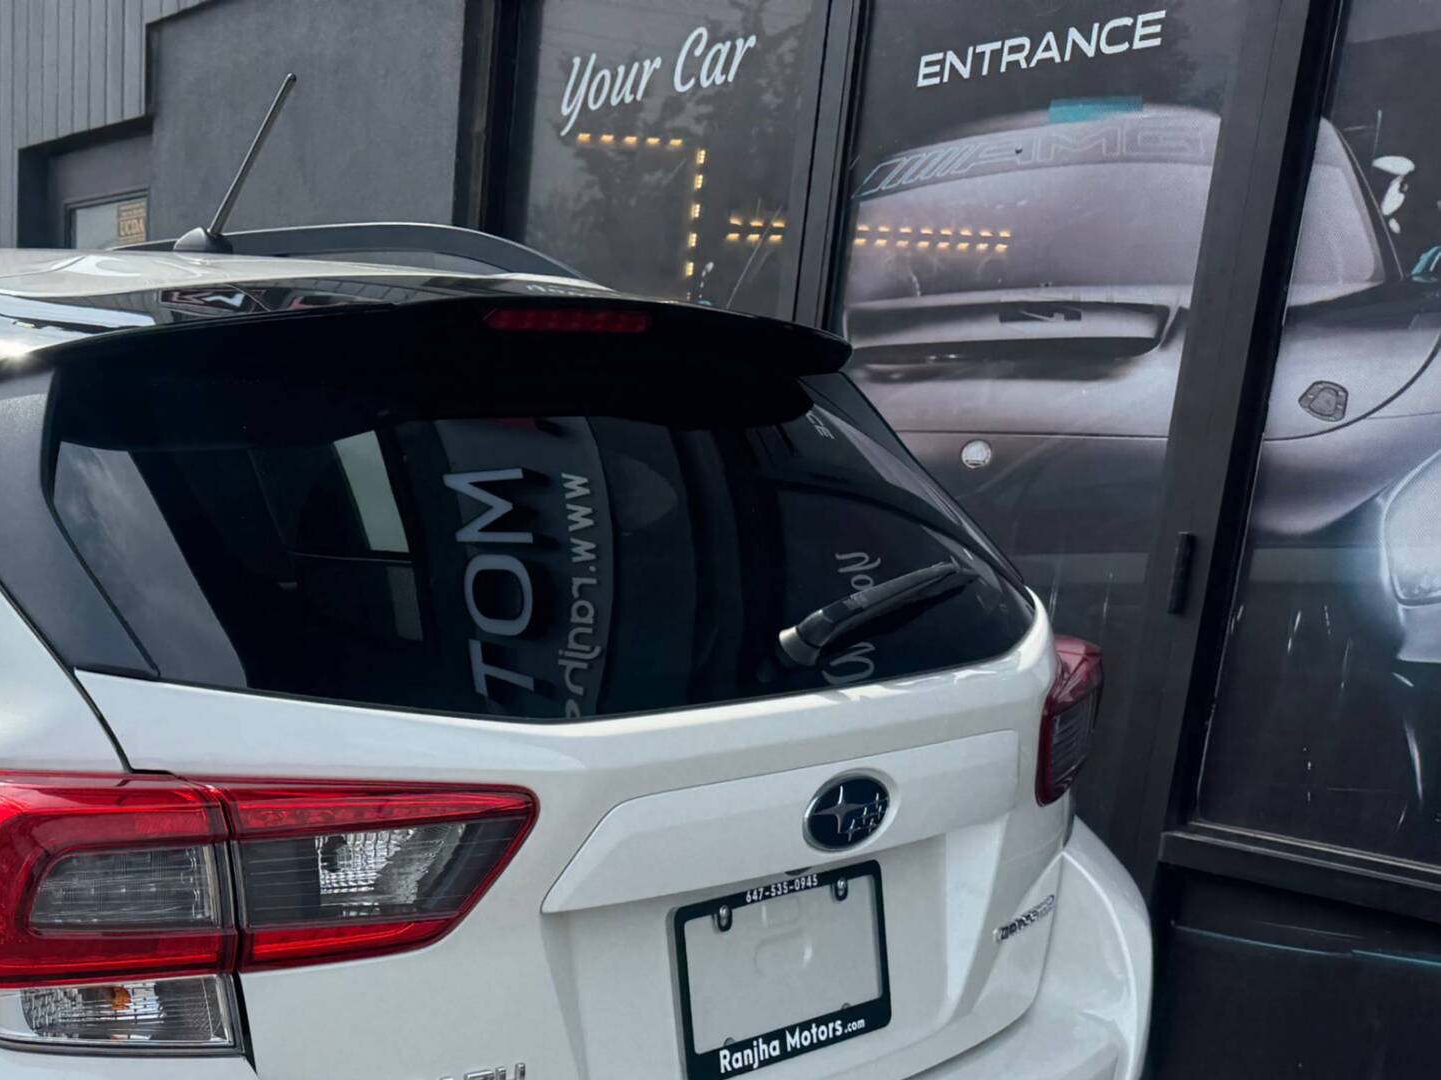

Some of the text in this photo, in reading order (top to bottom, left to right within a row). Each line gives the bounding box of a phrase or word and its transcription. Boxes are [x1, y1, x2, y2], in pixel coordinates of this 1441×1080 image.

[916, 10, 1167, 87] ENTRANCE
[560, 26, 757, 136] Your Car
[745, 873, 818, 903] 647-535-0945
[719, 1036, 781, 1074] Ranjha
